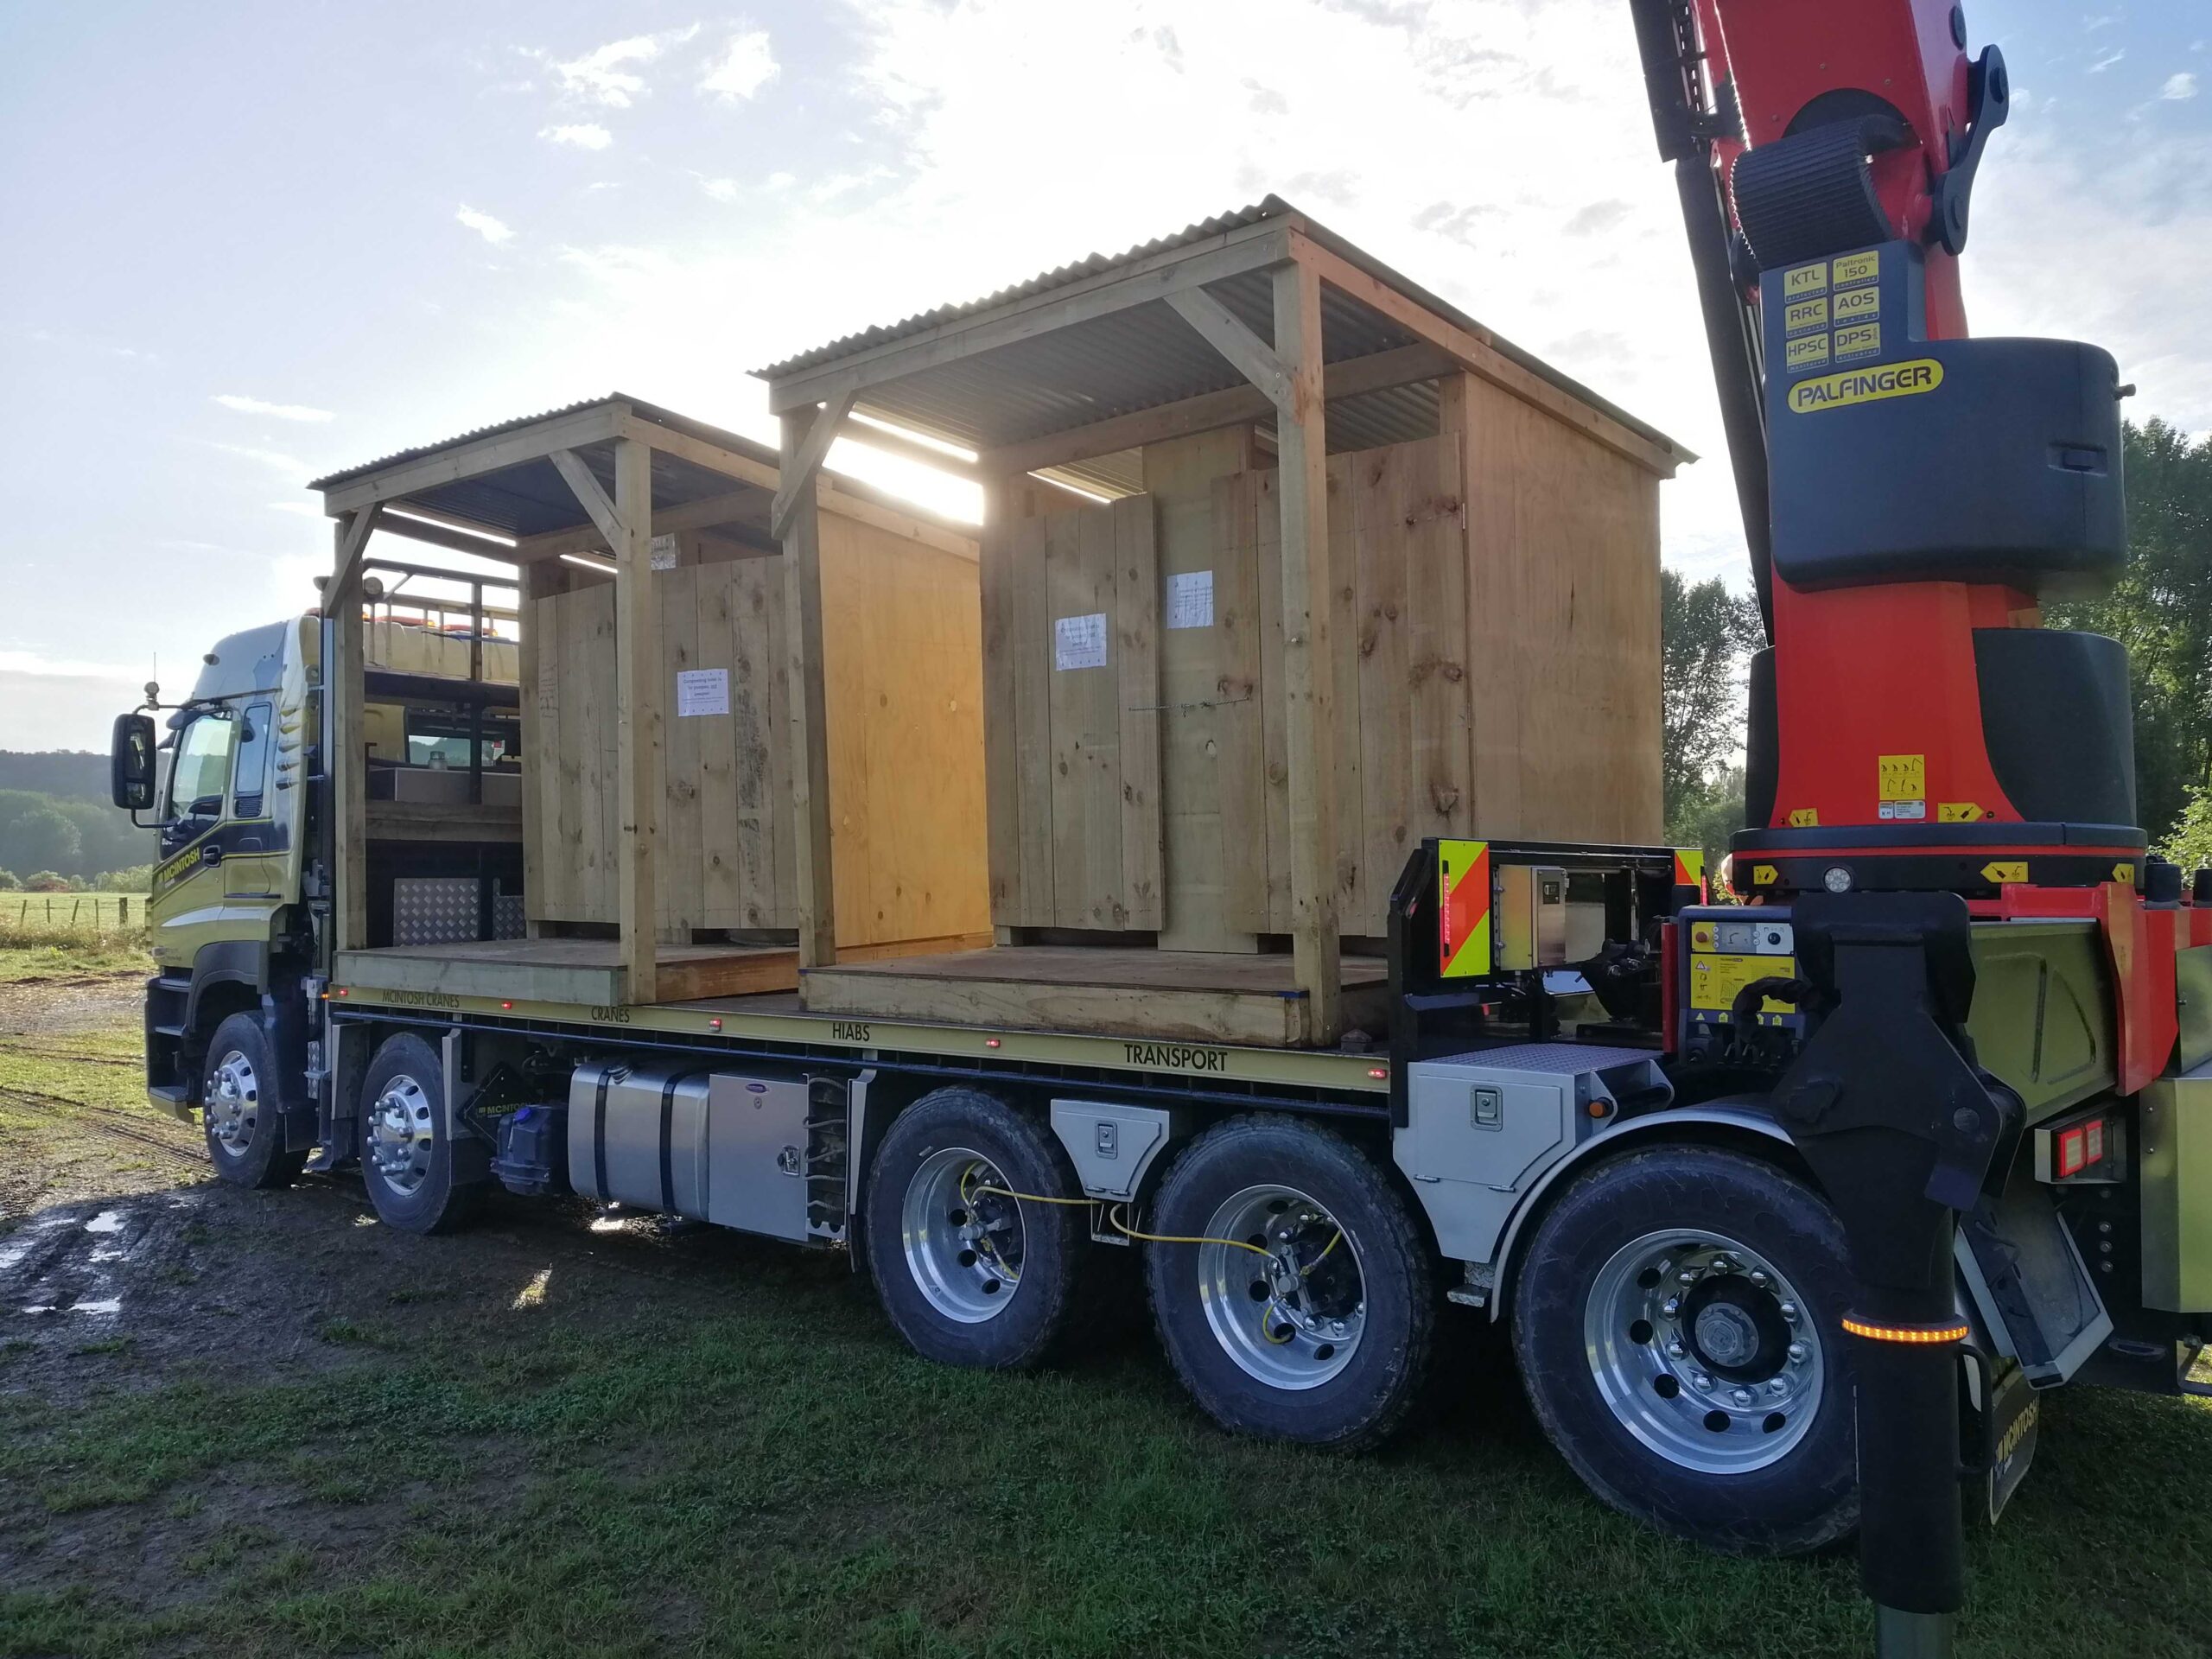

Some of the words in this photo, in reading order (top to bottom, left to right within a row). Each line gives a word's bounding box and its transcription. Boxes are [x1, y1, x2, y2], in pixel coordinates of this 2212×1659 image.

[1836, 255, 1875, 269] Paltronic
[1844, 264, 1868, 278] 150
[1791, 269, 1820, 286] KTL
[1838, 291, 1875, 310] AOS
[1790, 303, 1823, 322] RRC
[1837, 328, 1872, 347] DPS
[1788, 338, 1827, 358] HPSC
[1797, 365, 1932, 407] PALFINGER
[163, 847, 200, 883] MCINTOSH
[382, 991, 424, 1007] MCINTOSH
[427, 993, 460, 1009] CRANES
[591, 1006, 630, 1023] CRANES
[832, 1022, 870, 1042] HIABS
[1123, 1043, 1228, 1071] TRANSPORT
